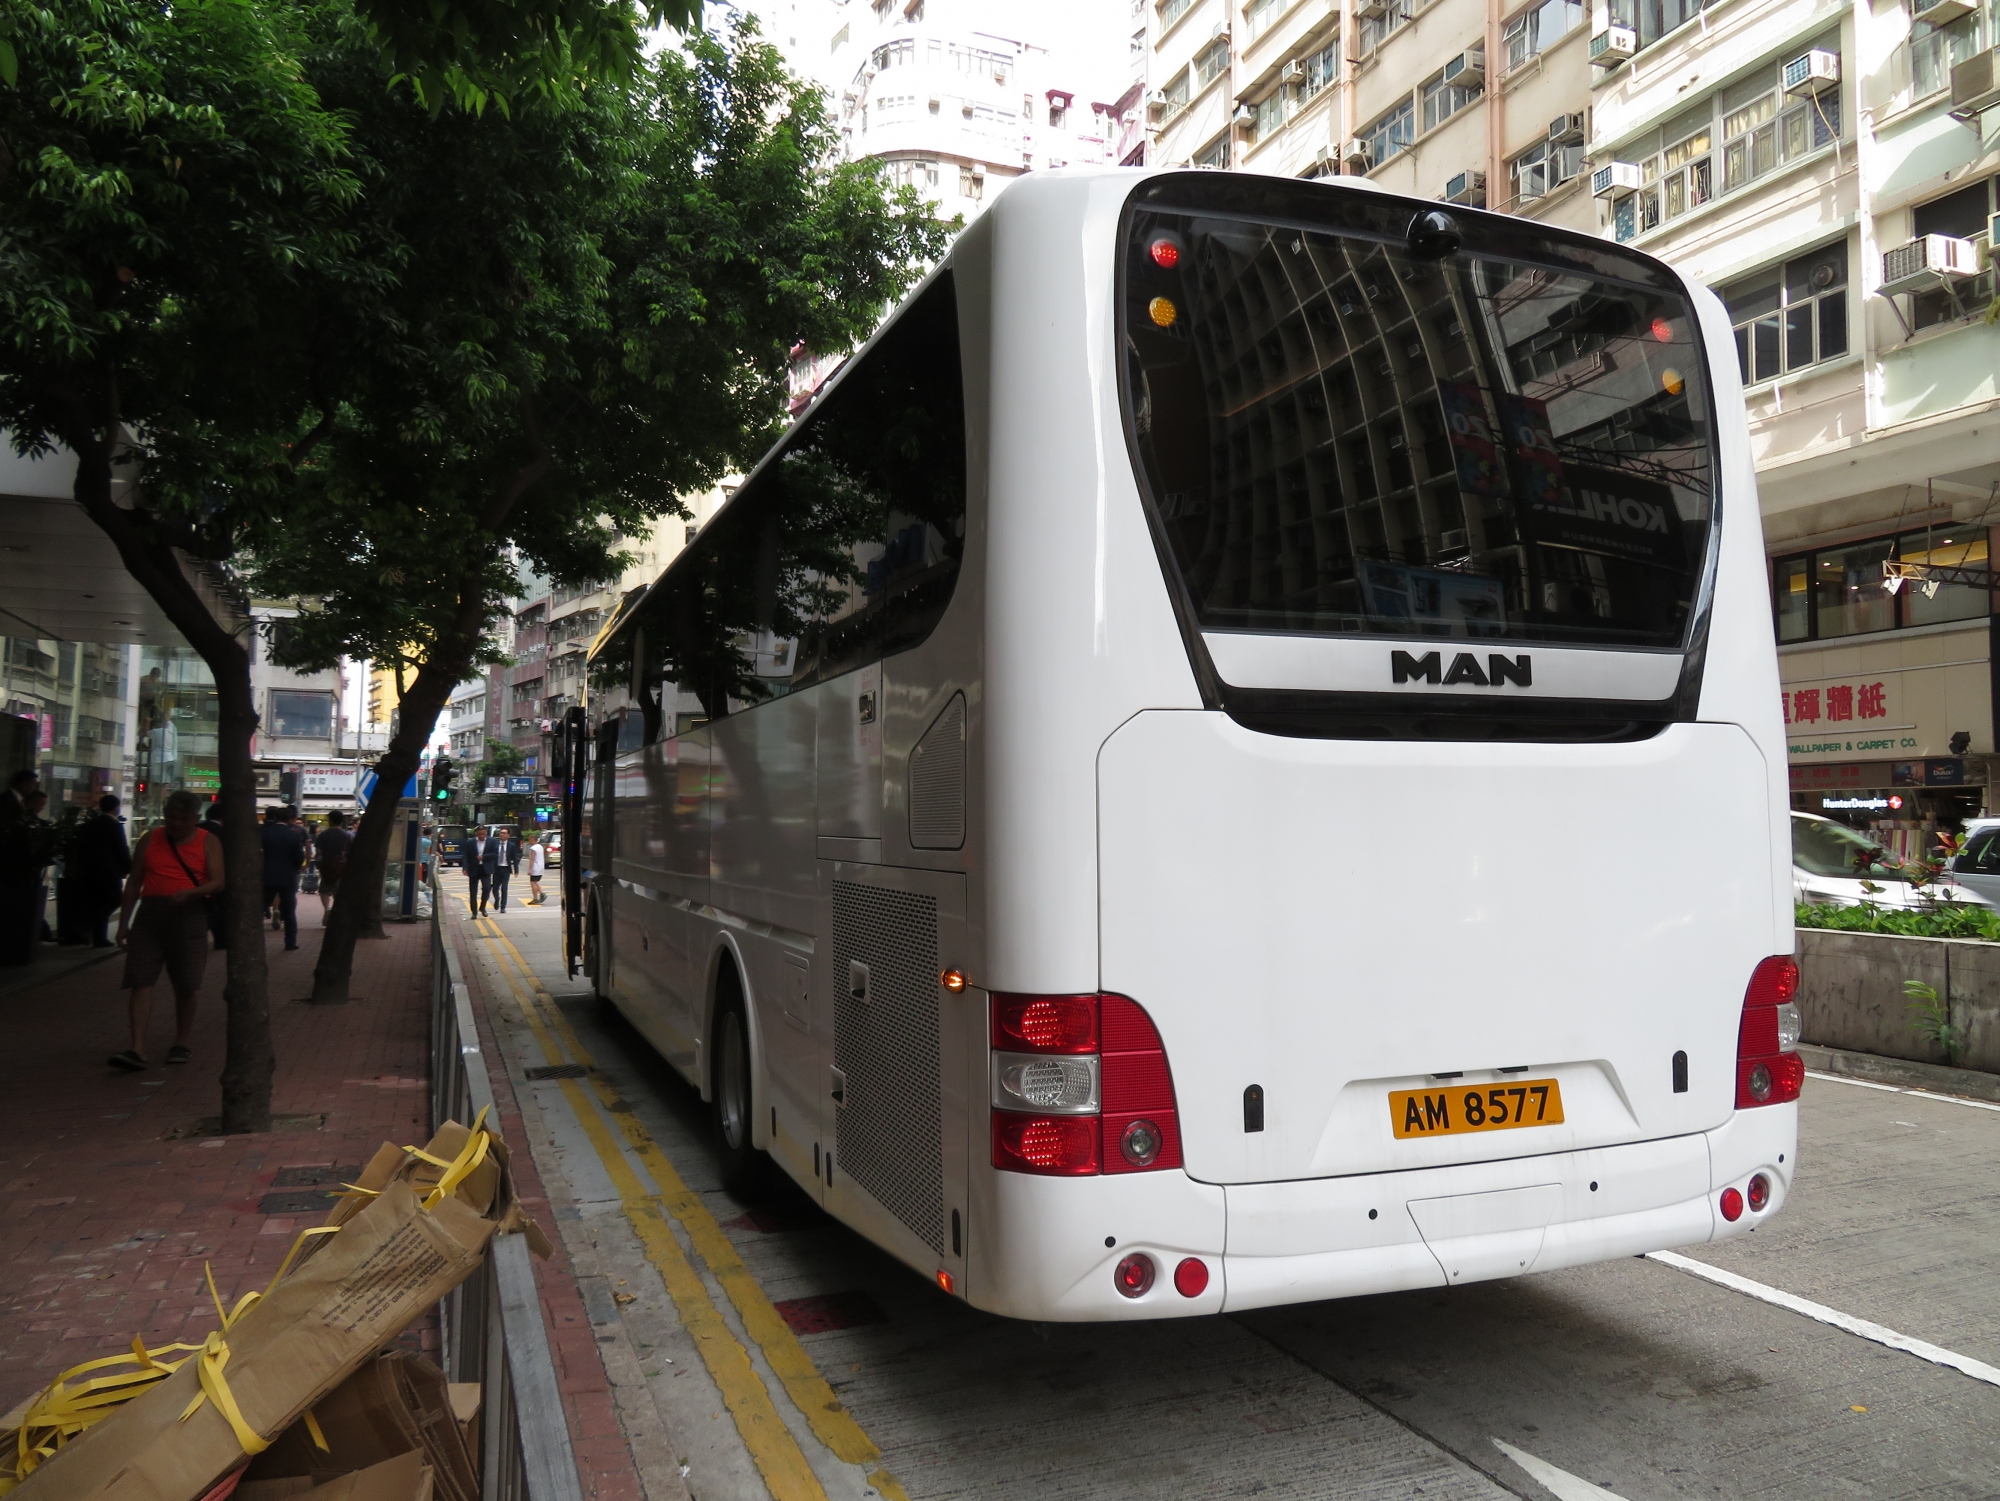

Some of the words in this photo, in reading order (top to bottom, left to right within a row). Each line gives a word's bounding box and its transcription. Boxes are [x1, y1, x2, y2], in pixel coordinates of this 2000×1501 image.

[1391, 650, 1532, 686] MAN
[1789, 742, 1842, 754] WALLPAPER
[1845, 742, 1852, 751] &
[1857, 739, 1895, 750] CARPET
[1900, 737, 1917, 748] CO.
[289, 767, 356, 776] Wnderfloor
[1822, 797, 1888, 809] HunterDouglas
[1405, 1094, 1449, 1132] AM
[1464, 1086, 1549, 1126] 8577
